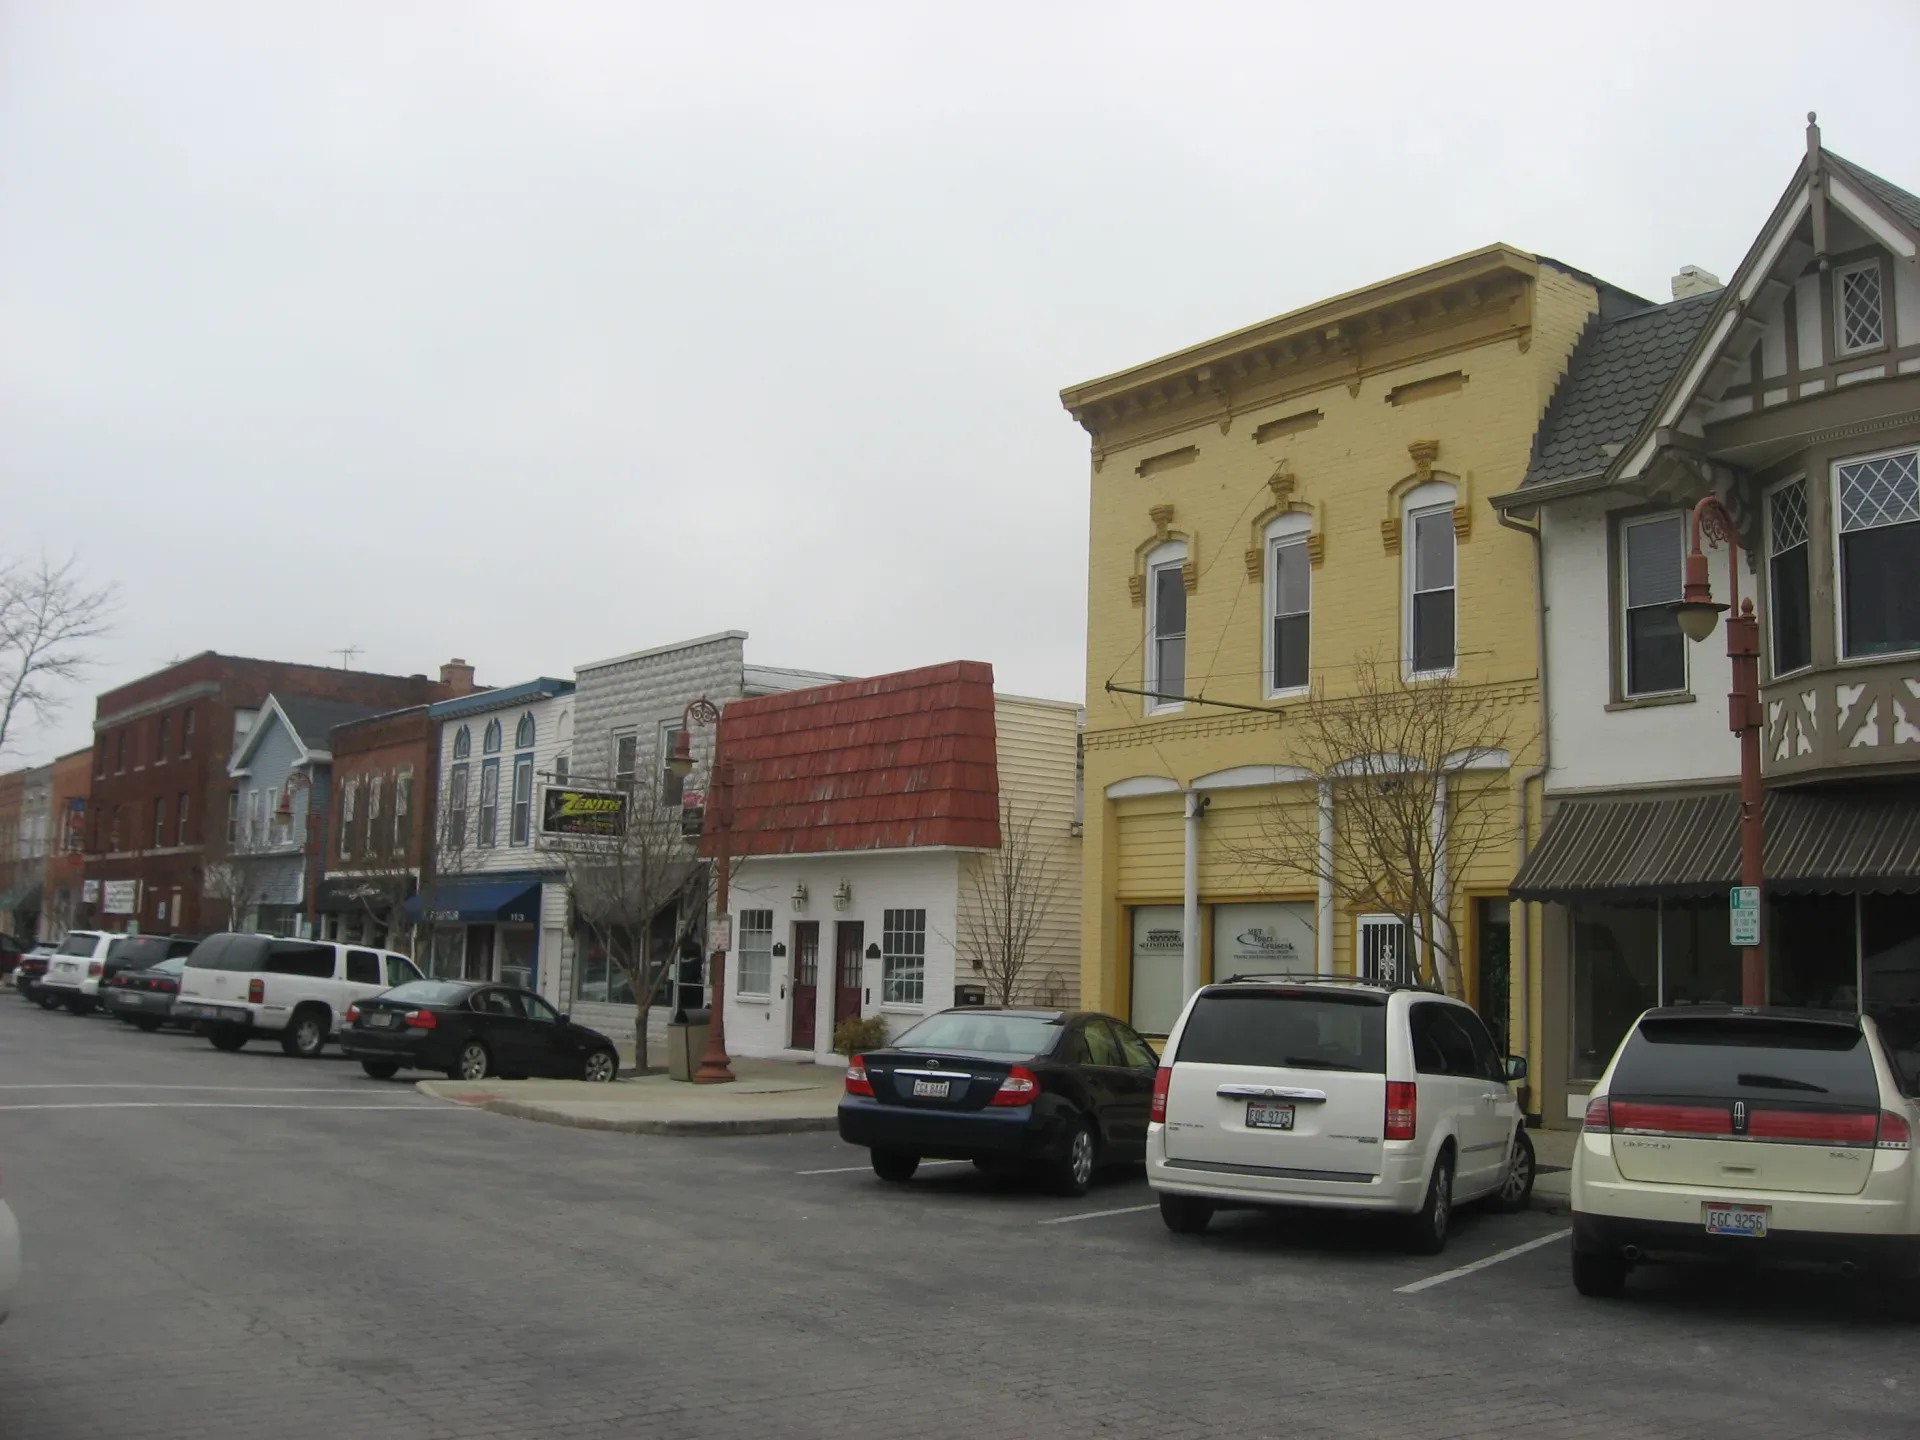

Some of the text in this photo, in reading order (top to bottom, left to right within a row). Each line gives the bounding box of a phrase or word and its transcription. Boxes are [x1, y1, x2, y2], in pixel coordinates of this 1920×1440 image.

[511, 913, 525, 921] 113
[1268, 1111, 1290, 1123] 9775
[1710, 1211, 1763, 1230] EGC 9256
